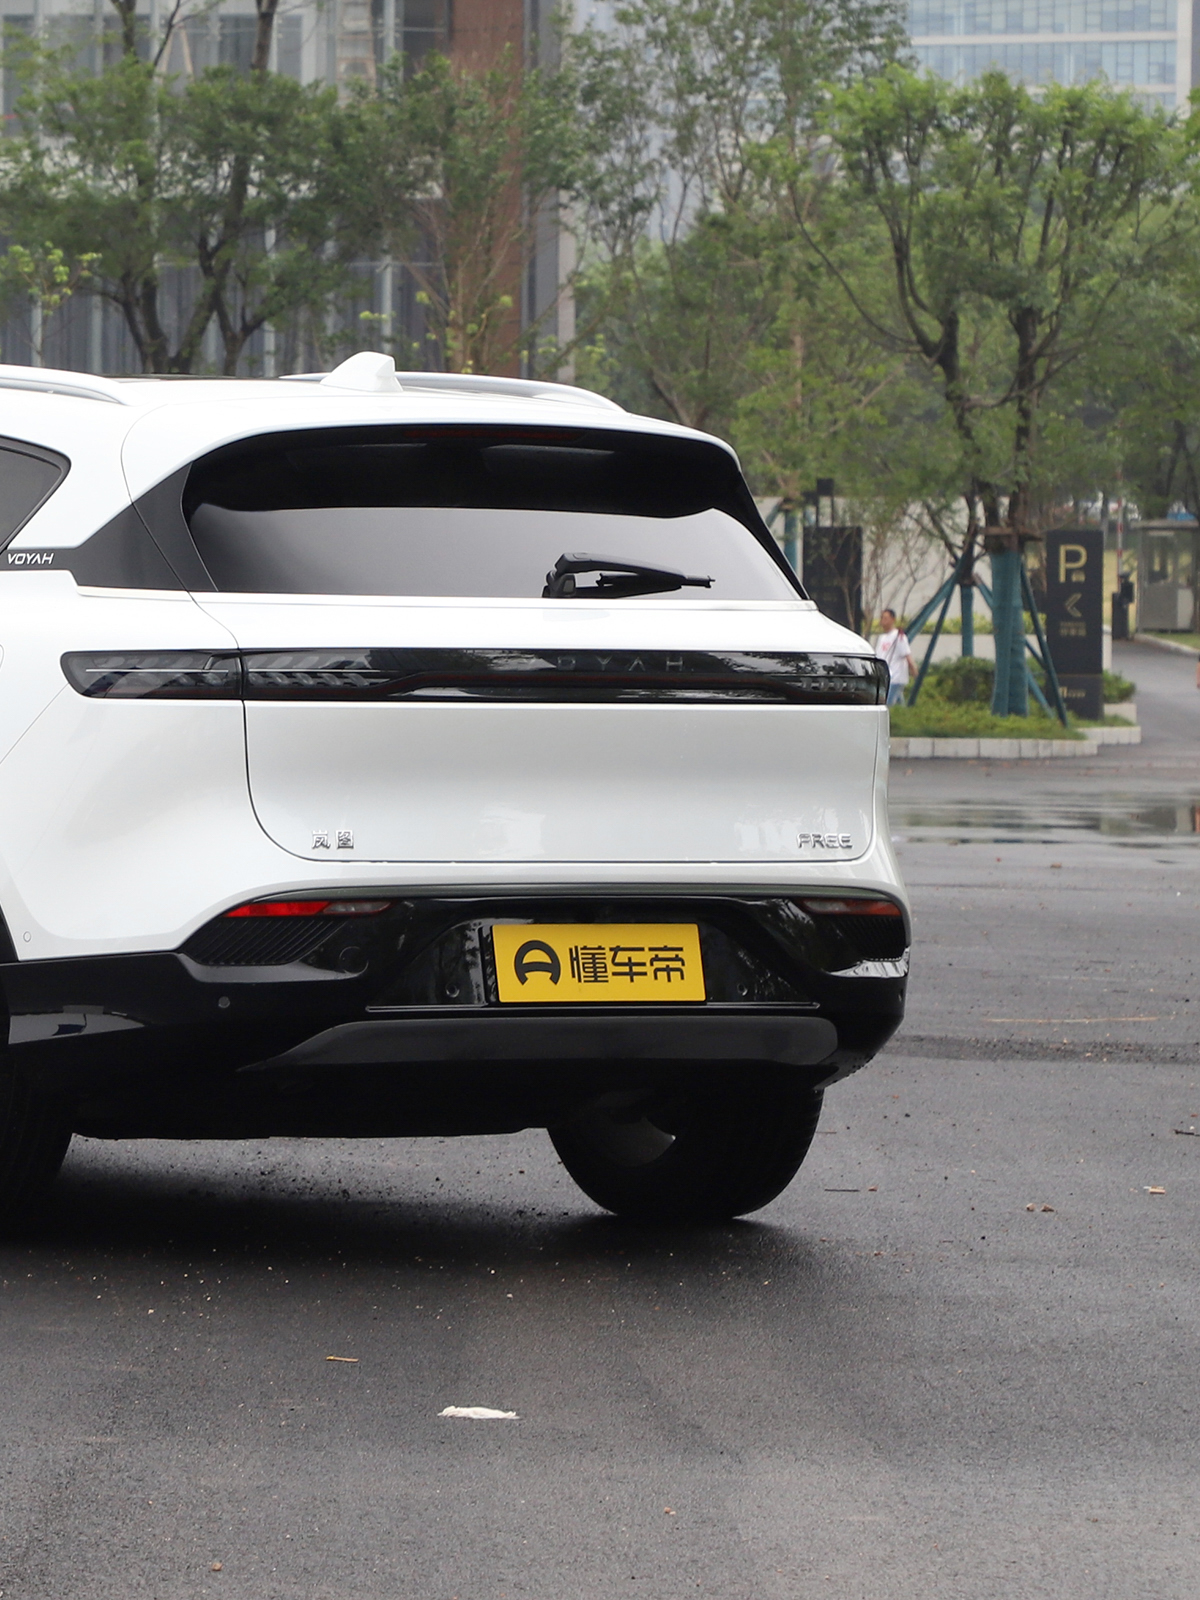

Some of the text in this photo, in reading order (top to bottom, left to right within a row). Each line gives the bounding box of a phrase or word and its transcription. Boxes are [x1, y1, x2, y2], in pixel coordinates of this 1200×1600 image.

[8, 552, 54, 565] VOYAH
[1059, 544, 1088, 583] P
[557, 656, 684, 671] OYAH
[312, 830, 354, 849] 岚图
[797, 833, 853, 849] FREE
[569, 945, 685, 983] 懂车帝
